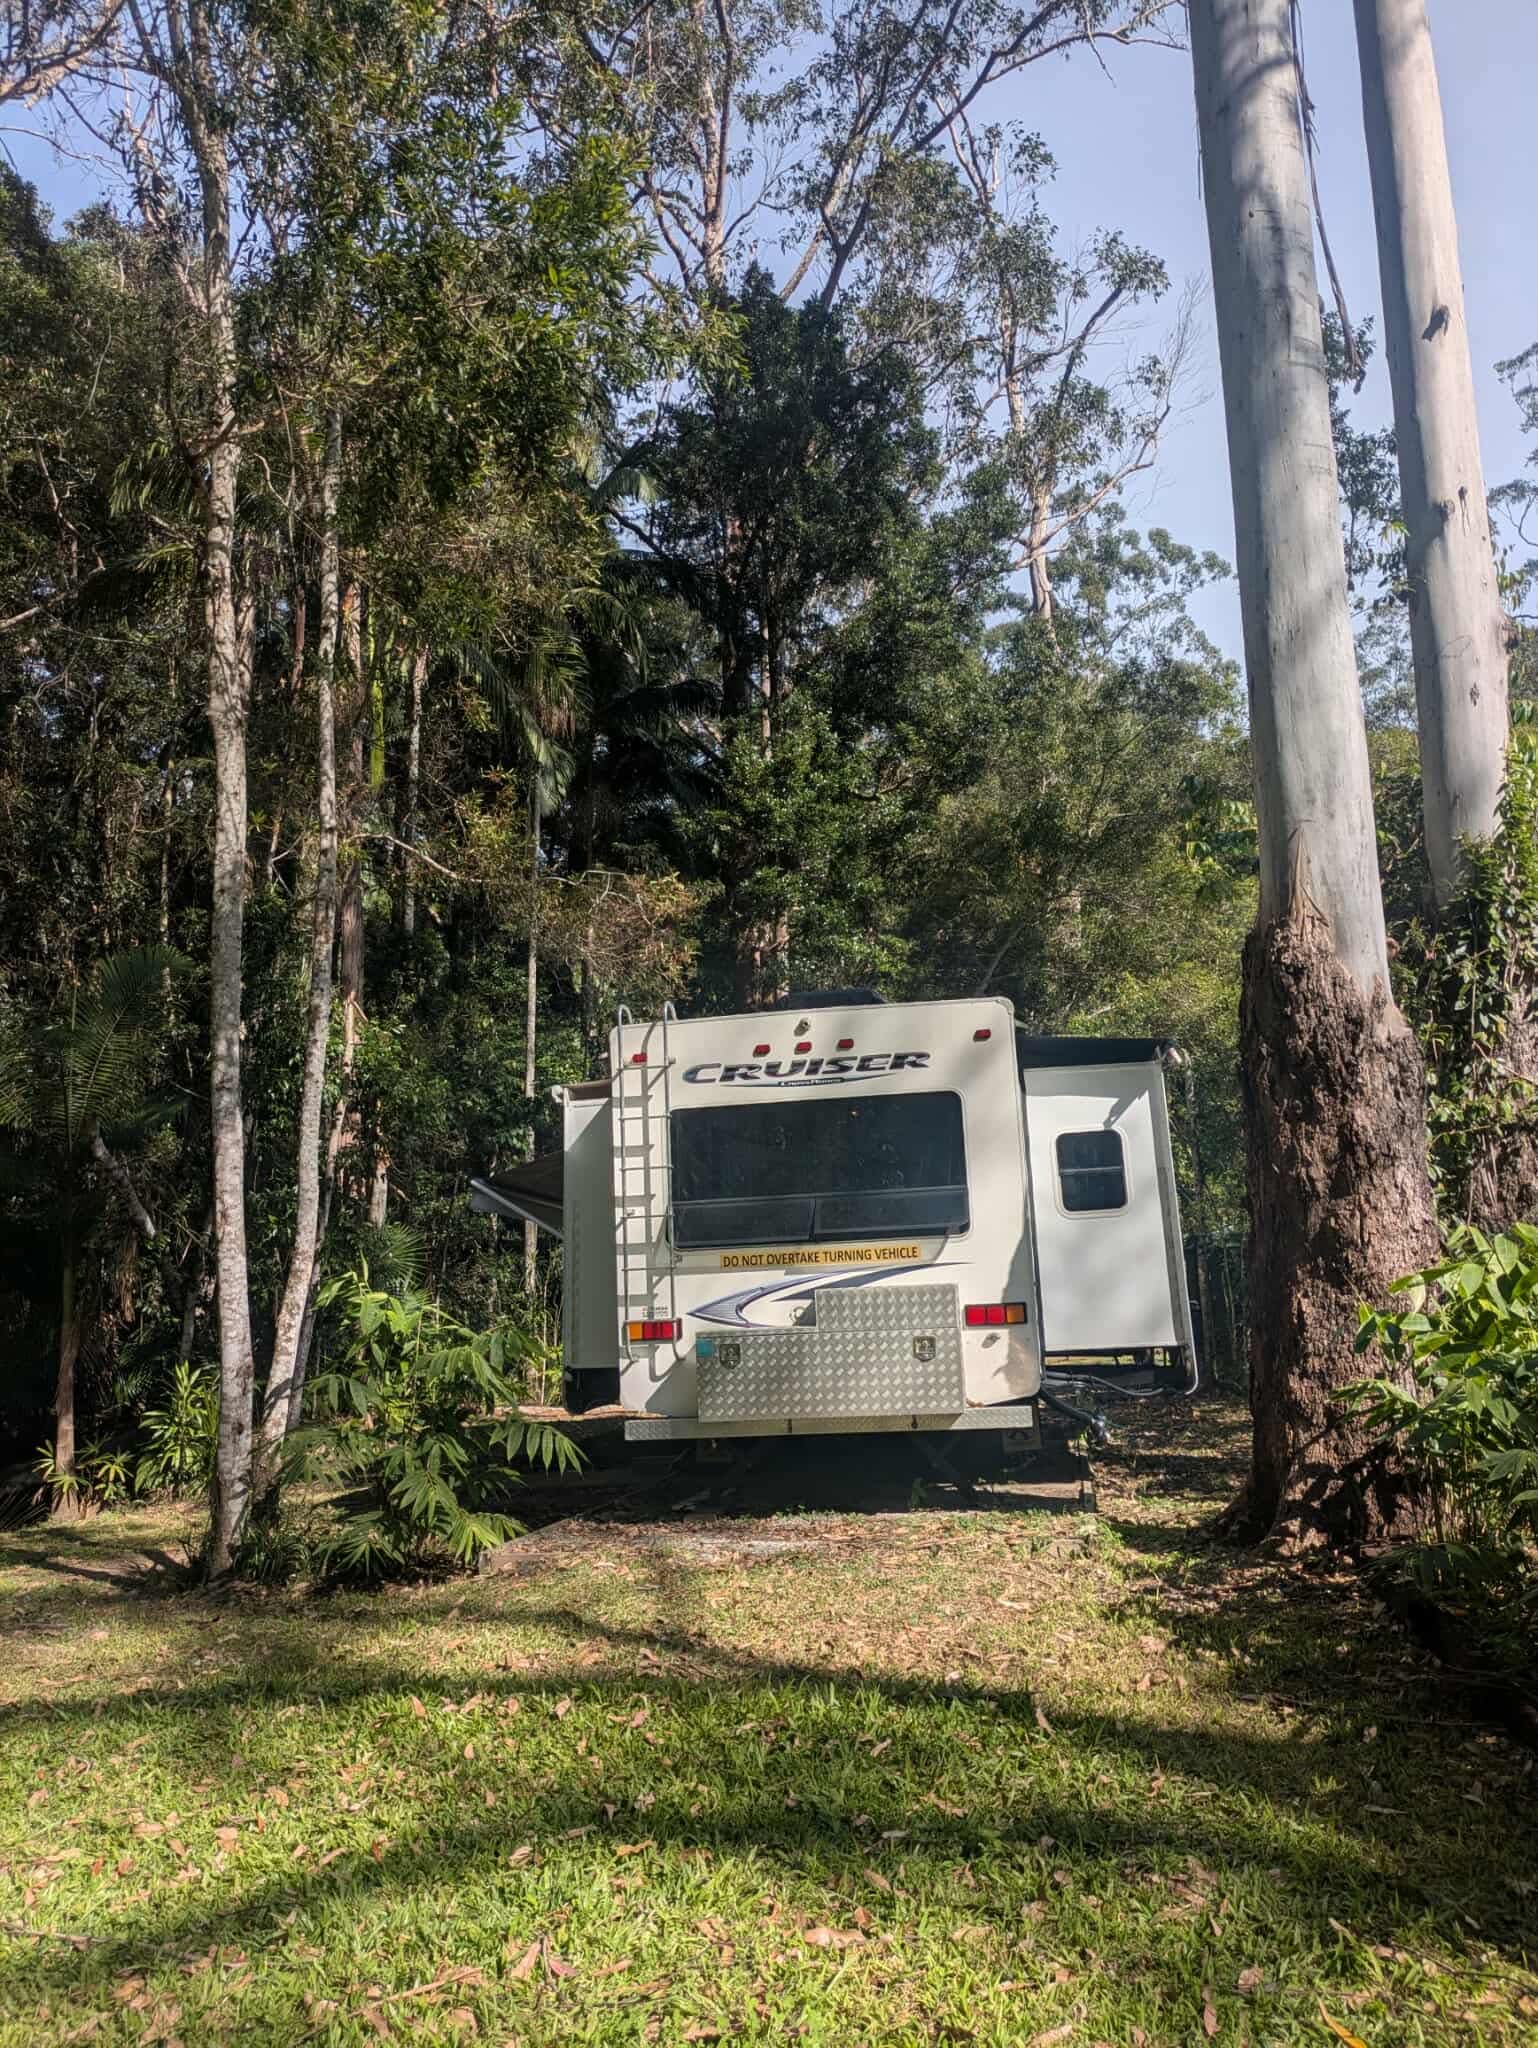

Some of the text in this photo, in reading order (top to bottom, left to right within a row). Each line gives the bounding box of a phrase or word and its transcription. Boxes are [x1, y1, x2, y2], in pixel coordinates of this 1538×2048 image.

[682, 1052, 931, 1083] CRUISER
[723, 1246, 918, 1268] DO NOT OVERTAKE TURNING VEHICLE
